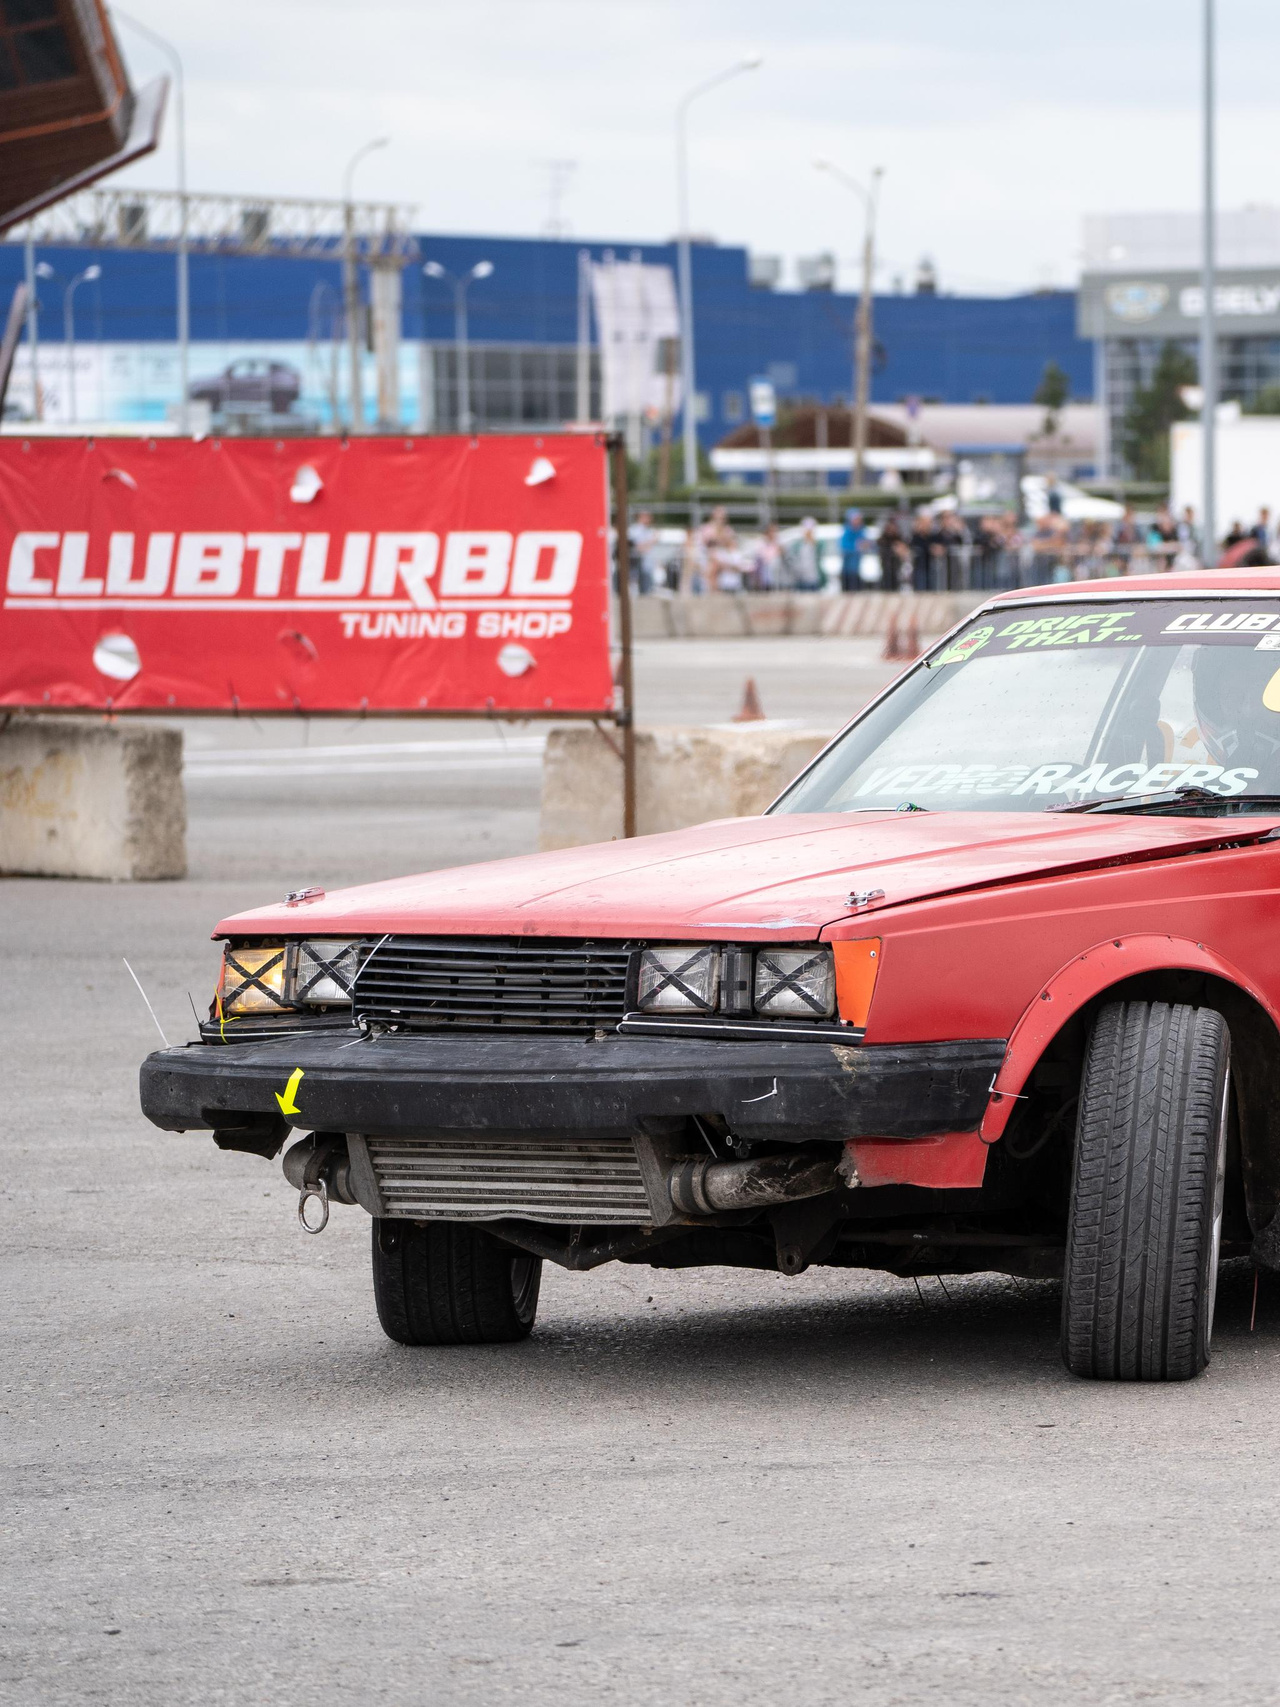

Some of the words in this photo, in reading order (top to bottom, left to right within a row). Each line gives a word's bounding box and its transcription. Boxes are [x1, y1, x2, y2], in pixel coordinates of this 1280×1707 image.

[7, 531, 584, 609] CLUBTURBO
[341, 613, 466, 638] TUNING
[475, 613, 572, 637] SHOP
[996, 611, 1136, 637] DRIFT
